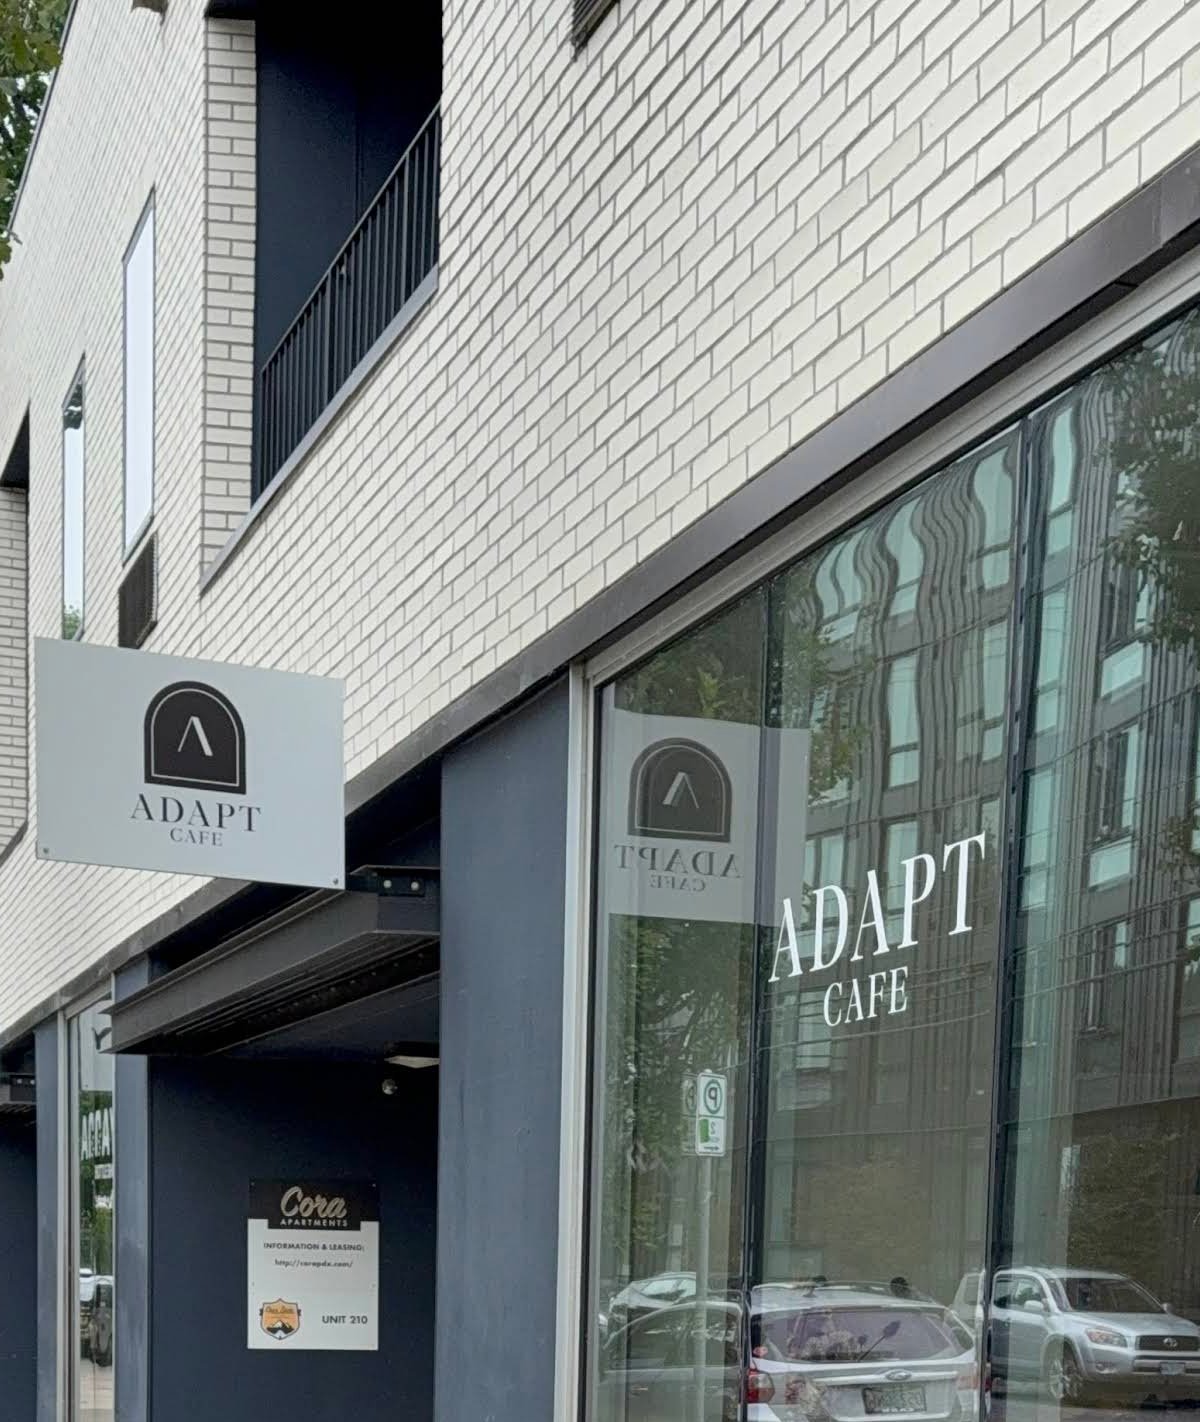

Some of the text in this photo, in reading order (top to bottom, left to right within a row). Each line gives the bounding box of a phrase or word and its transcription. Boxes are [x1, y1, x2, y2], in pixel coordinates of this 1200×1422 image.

[130, 793, 261, 832] ADAPT
[170, 827, 223, 847] CAFE
[768, 831, 986, 983] ADAPT
[823, 966, 908, 1027] CAFE
[280, 1186, 347, 1218] Cora
[279, 1218, 348, 1227] APARTMENTS
[263, 1242, 320, 1250] INFORMATION
[321, 1243, 328, 1251] &
[321, 1315, 368, 1325] UNIT 210
